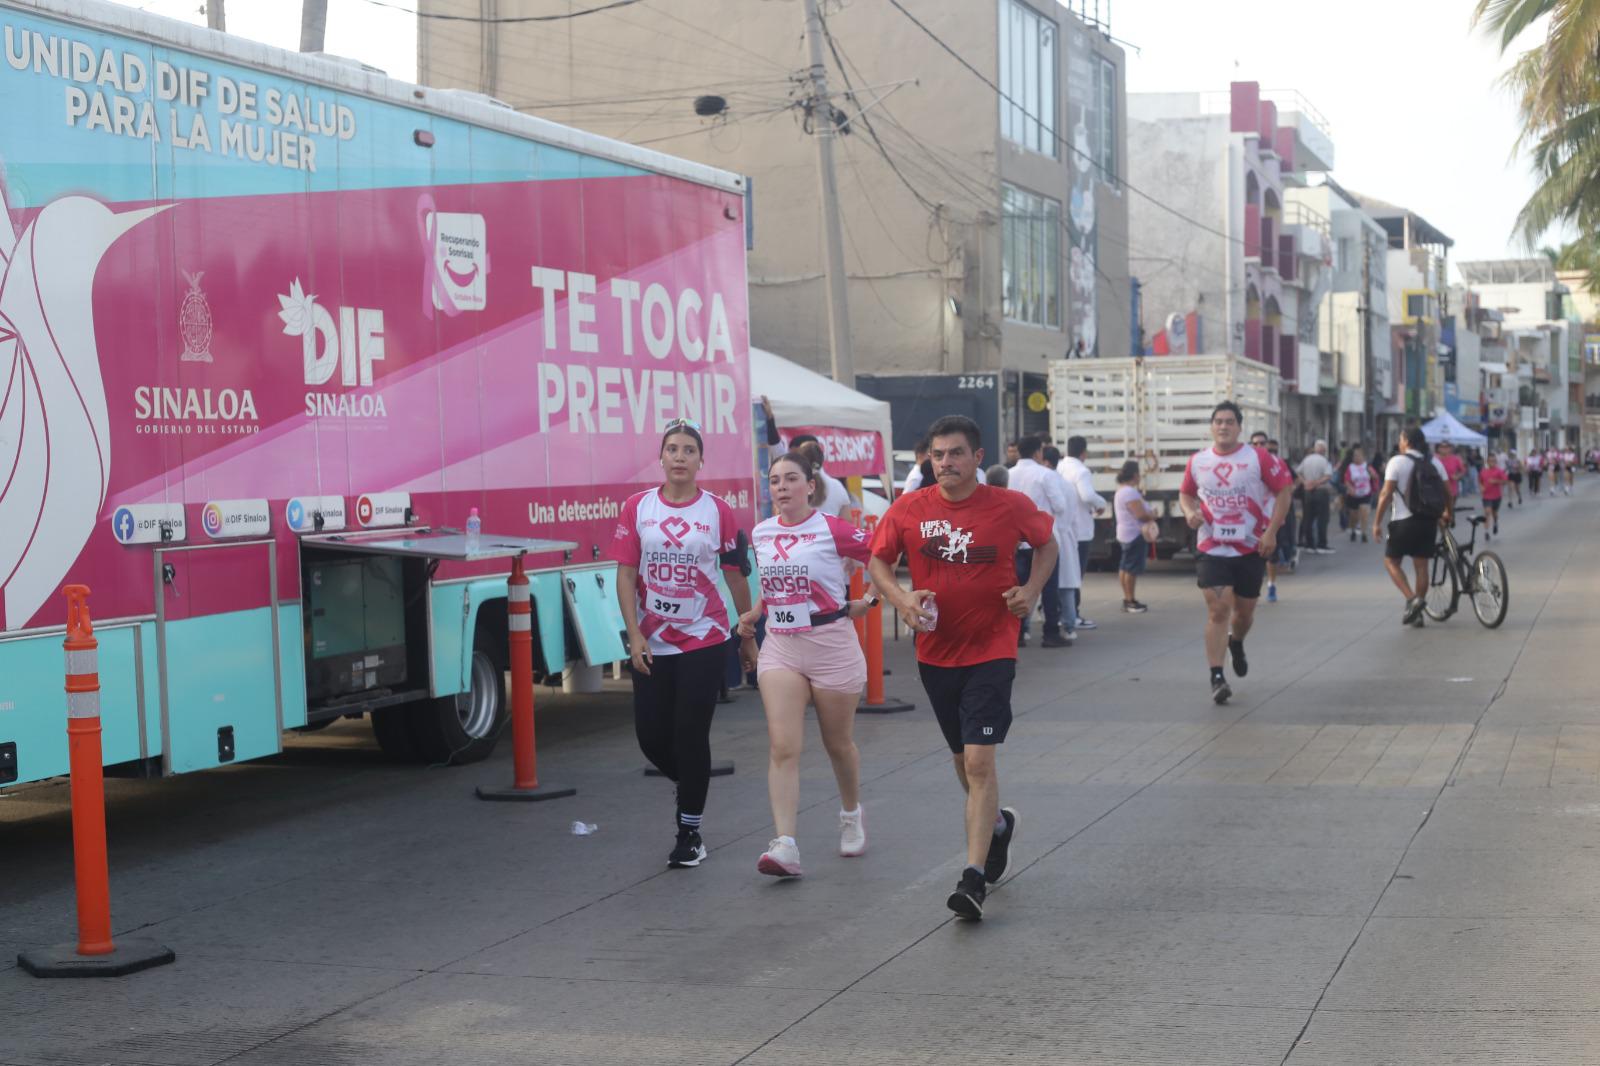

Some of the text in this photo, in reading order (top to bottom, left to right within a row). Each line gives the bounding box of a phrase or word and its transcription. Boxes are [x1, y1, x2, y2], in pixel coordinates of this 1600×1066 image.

[4, 25, 357, 140] UNIDAD DIF DE SALUD
[65, 86, 317, 172] PARA LA MUJER
[440, 232, 480, 259] Recuperando Sonrisas
[531, 265, 735, 364] TE TOCA
[302, 301, 386, 387] DIF
[958, 376, 994, 391] 2264
[134, 386, 259, 420] SINALOA
[305, 392, 388, 417] SINALOA
[537, 361, 738, 435] PREVENIR
[136, 424, 260, 435] GOBIERNO DEL ESTADO
[243, 513, 267, 524] Sinaloa
[385, 504, 403, 514] Sinaloa
[528, 502, 555, 524] Una
[558, 496, 618, 523] detección
[920, 527, 946, 539] TEAM
[1220, 527, 1237, 536] 719
[647, 562, 699, 584] ROSA
[760, 565, 809, 577] CARRERA
[761, 576, 810, 594] ROSA
[654, 598, 681, 614] 397
